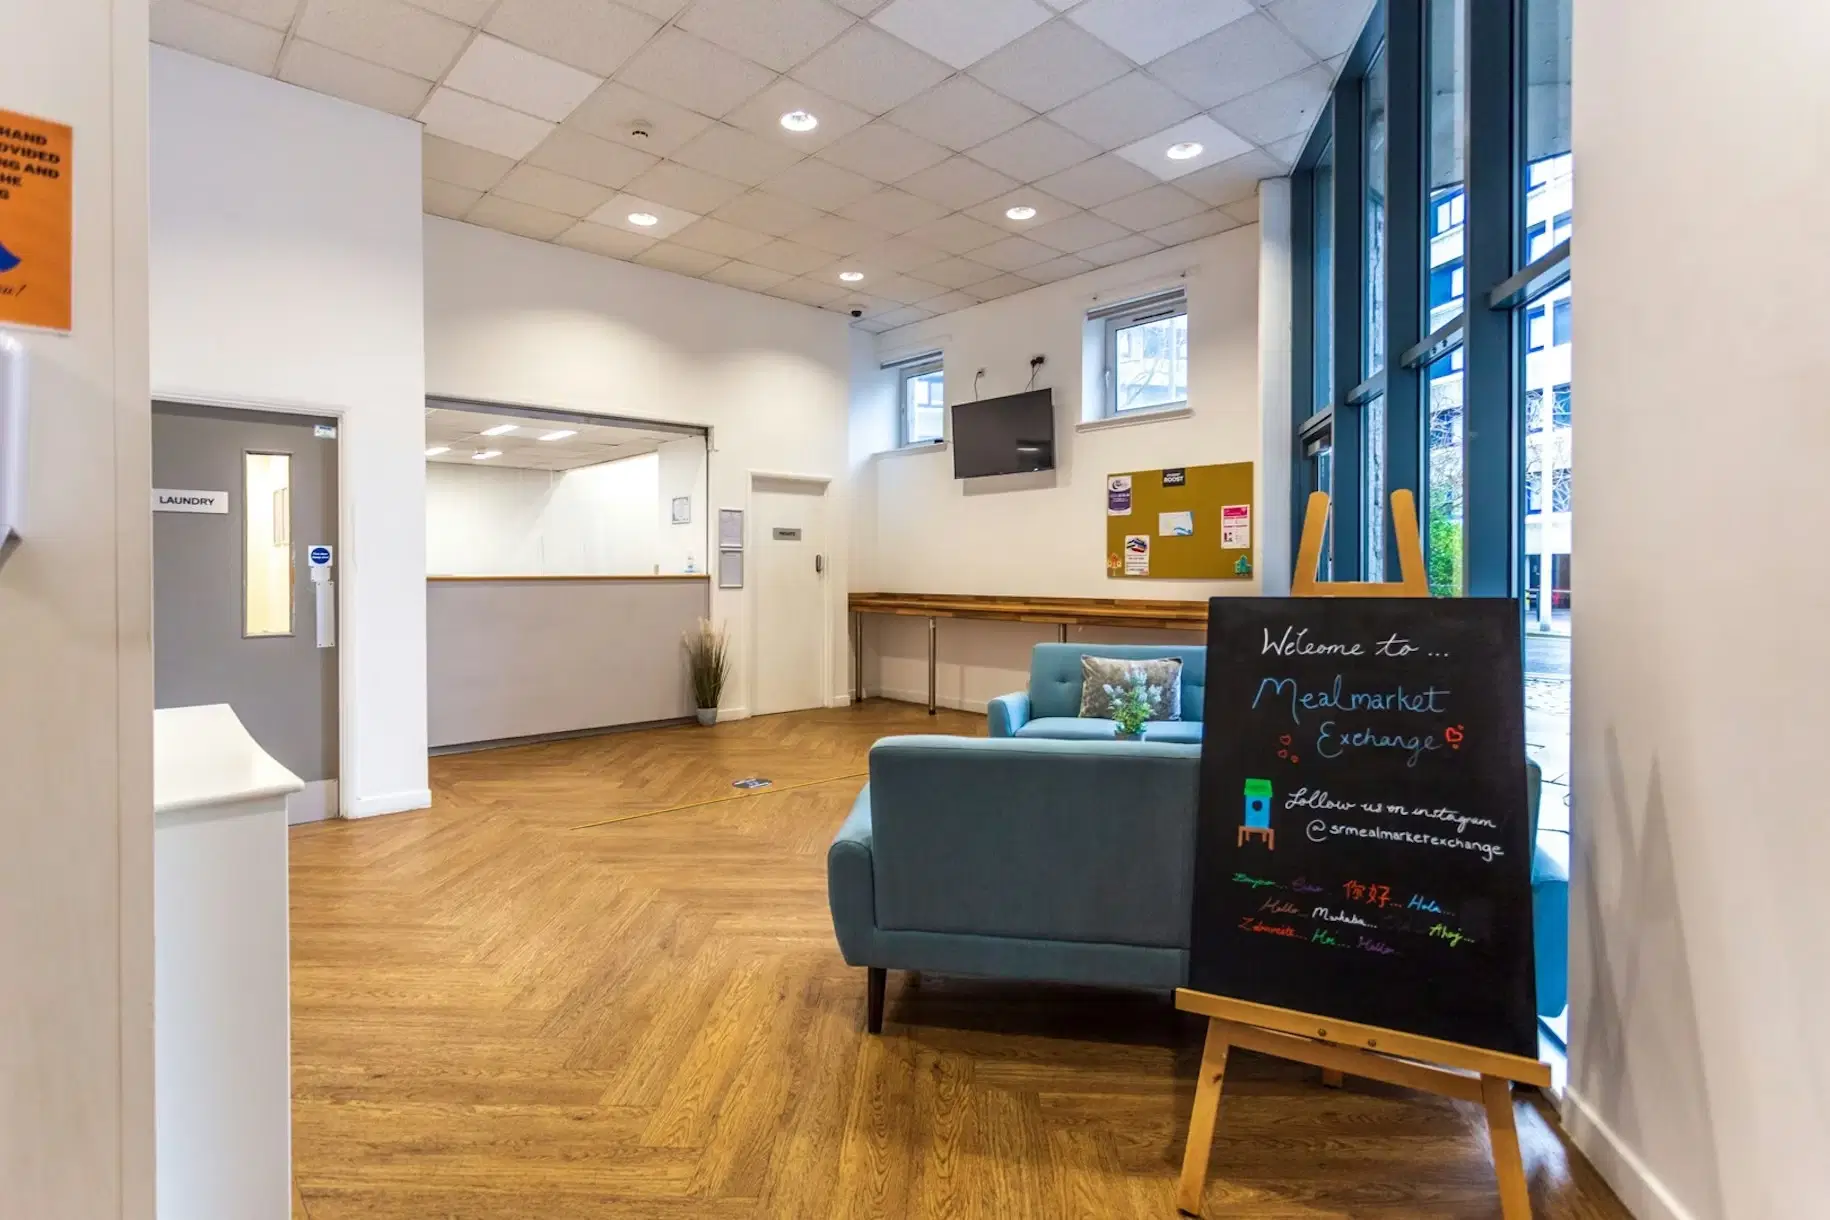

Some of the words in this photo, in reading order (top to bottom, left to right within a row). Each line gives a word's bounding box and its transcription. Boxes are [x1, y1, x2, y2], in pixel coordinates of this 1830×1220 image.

[0, 126, 47, 146] HAND
[24, 163, 60, 179] AND
[159, 496, 215, 506] LAUNDRY
[1261, 626, 1364, 656] Welcome
[1376, 633, 1420, 657] to
[1252, 674, 1451, 725] Mealmarket
[1316, 721, 1443, 767] Exchange
[1285, 787, 1356, 810] Follow
[1360, 803, 1383, 813] us
[1386, 804, 1409, 816] on
[1411, 807, 1497, 834] instagram
